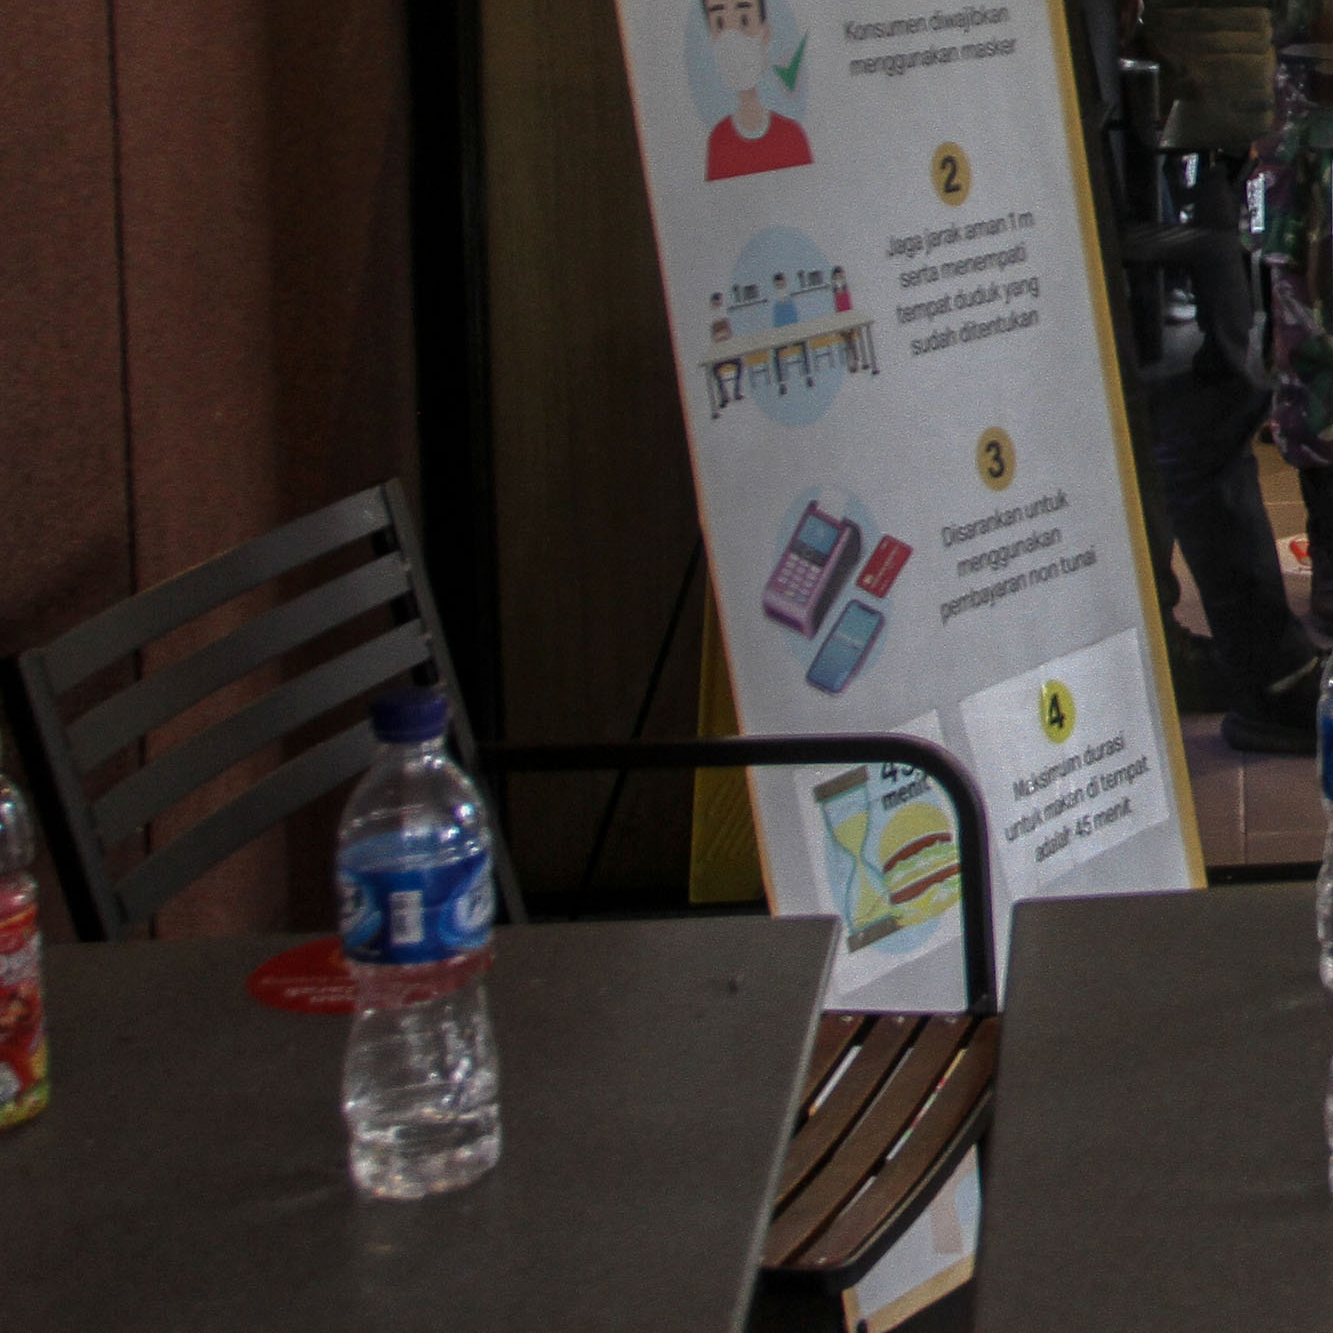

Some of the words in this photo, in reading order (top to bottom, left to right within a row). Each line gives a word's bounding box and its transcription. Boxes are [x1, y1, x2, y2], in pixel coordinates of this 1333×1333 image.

[844, 17, 928, 41] Konsumen
[928, 5, 1010, 34] diwajibkan
[850, 43, 960, 77] menggunakan
[960, 37, 1017, 59] masker
[941, 156, 962, 194] 2
[886, 234, 924, 258] Jaga
[924, 223, 962, 255] jarak
[964, 218, 1007, 241] aman
[900, 265, 940, 289] serta
[941, 242, 1027, 279] menempati
[896, 295, 952, 325] tempat
[953, 281, 999, 310] duduk
[1001, 276, 1040, 305] yang
[911, 325, 959, 356] sudah
[959, 310, 1039, 343] ditentukan
[985, 440, 1005, 479] 3
[942, 508, 1024, 548] Disarankan
[1024, 488, 1071, 520] untuk
[957, 527, 1062, 577] menggunakan
[940, 574, 1029, 626] pembayaran
[1028, 562, 1060, 587] non
[1060, 545, 1098, 575] tunai
[1048, 694, 1066, 730] 4
[1013, 754, 1083, 801] Maksimum
[1083, 730, 1126, 767] durasi
[1004, 807, 1045, 843] untuk
[1043, 788, 1086, 821] makan
[1086, 776, 1101, 799] di
[1100, 755, 1151, 792] tempat
[1035, 825, 1073, 863] adalah
[1075, 815, 1093, 837] 45
[1093, 796, 1133, 830] menit
